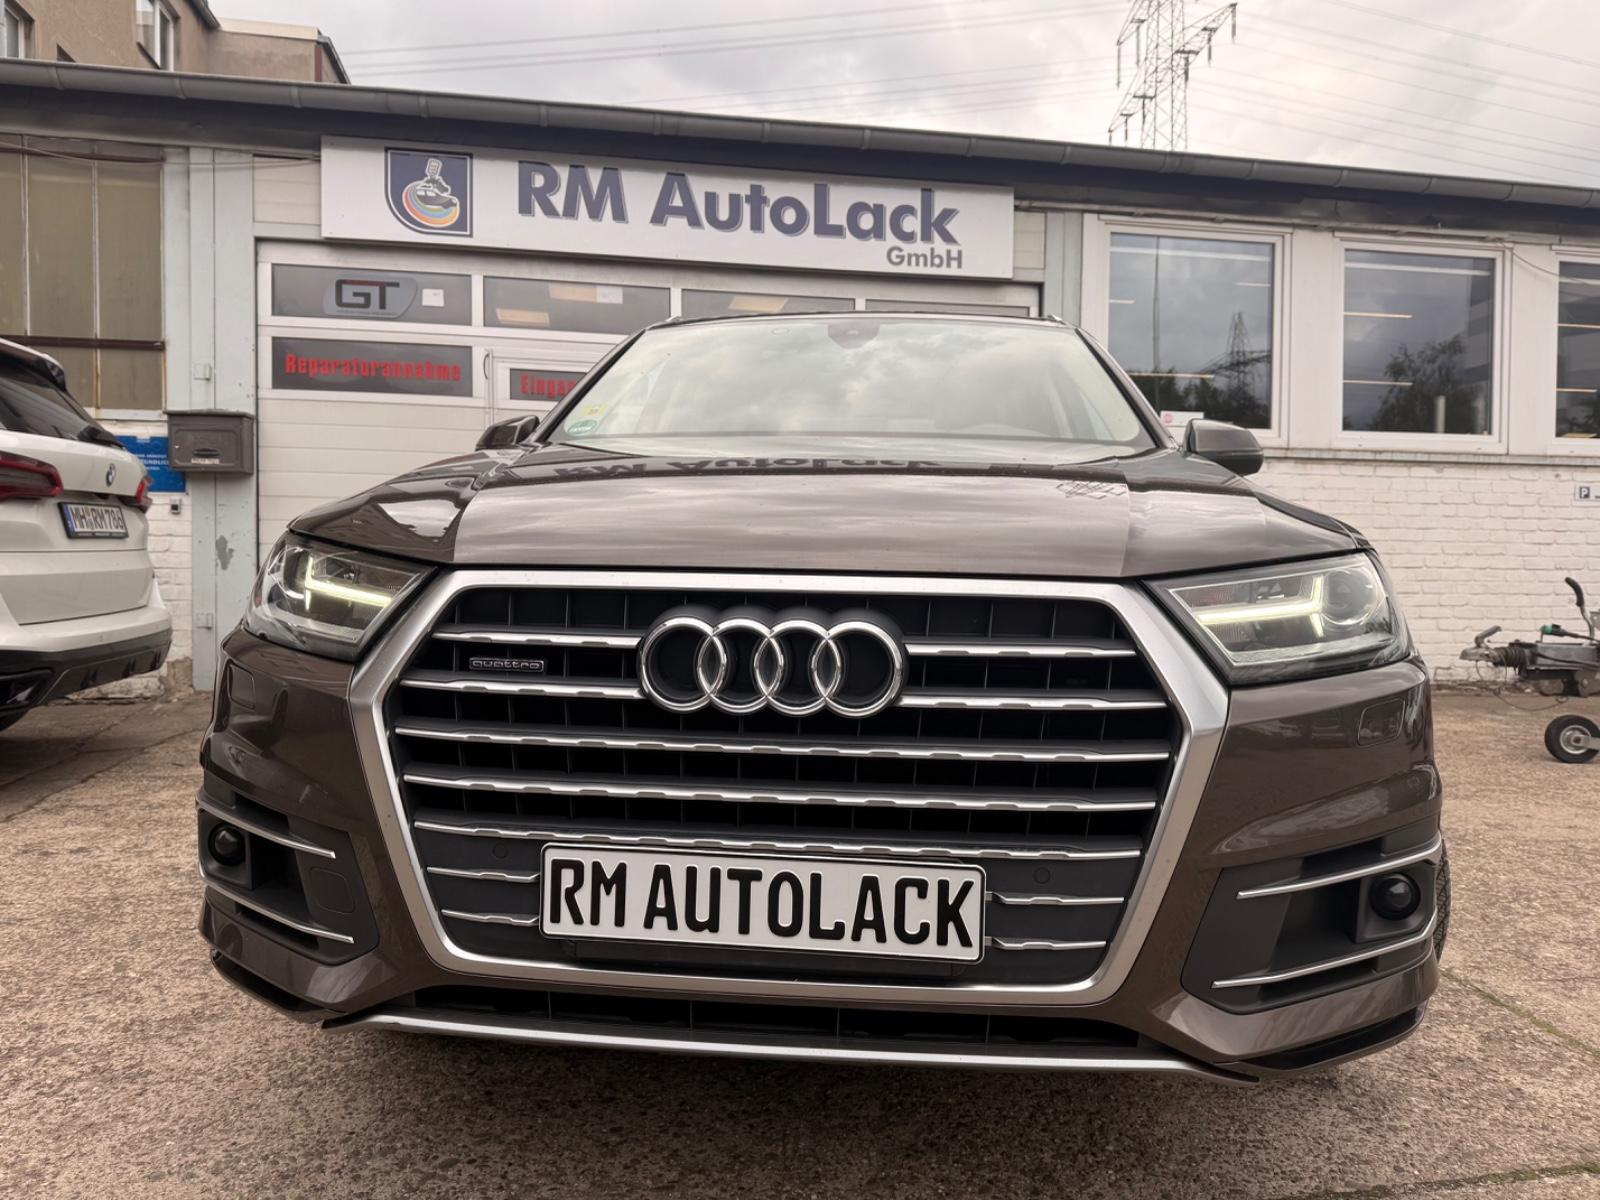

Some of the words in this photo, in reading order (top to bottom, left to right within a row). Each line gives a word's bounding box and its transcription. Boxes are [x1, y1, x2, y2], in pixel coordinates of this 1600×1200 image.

[518, 160, 628, 223] RM
[649, 172, 961, 245] AutoLack
[886, 246, 963, 269] GmbH
[335, 279, 400, 310] GT
[285, 352, 461, 382] Reparaturannahme
[472, 660, 540, 669] quattro
[550, 858, 627, 927] RM
[643, 864, 975, 947] AUTOLACK
